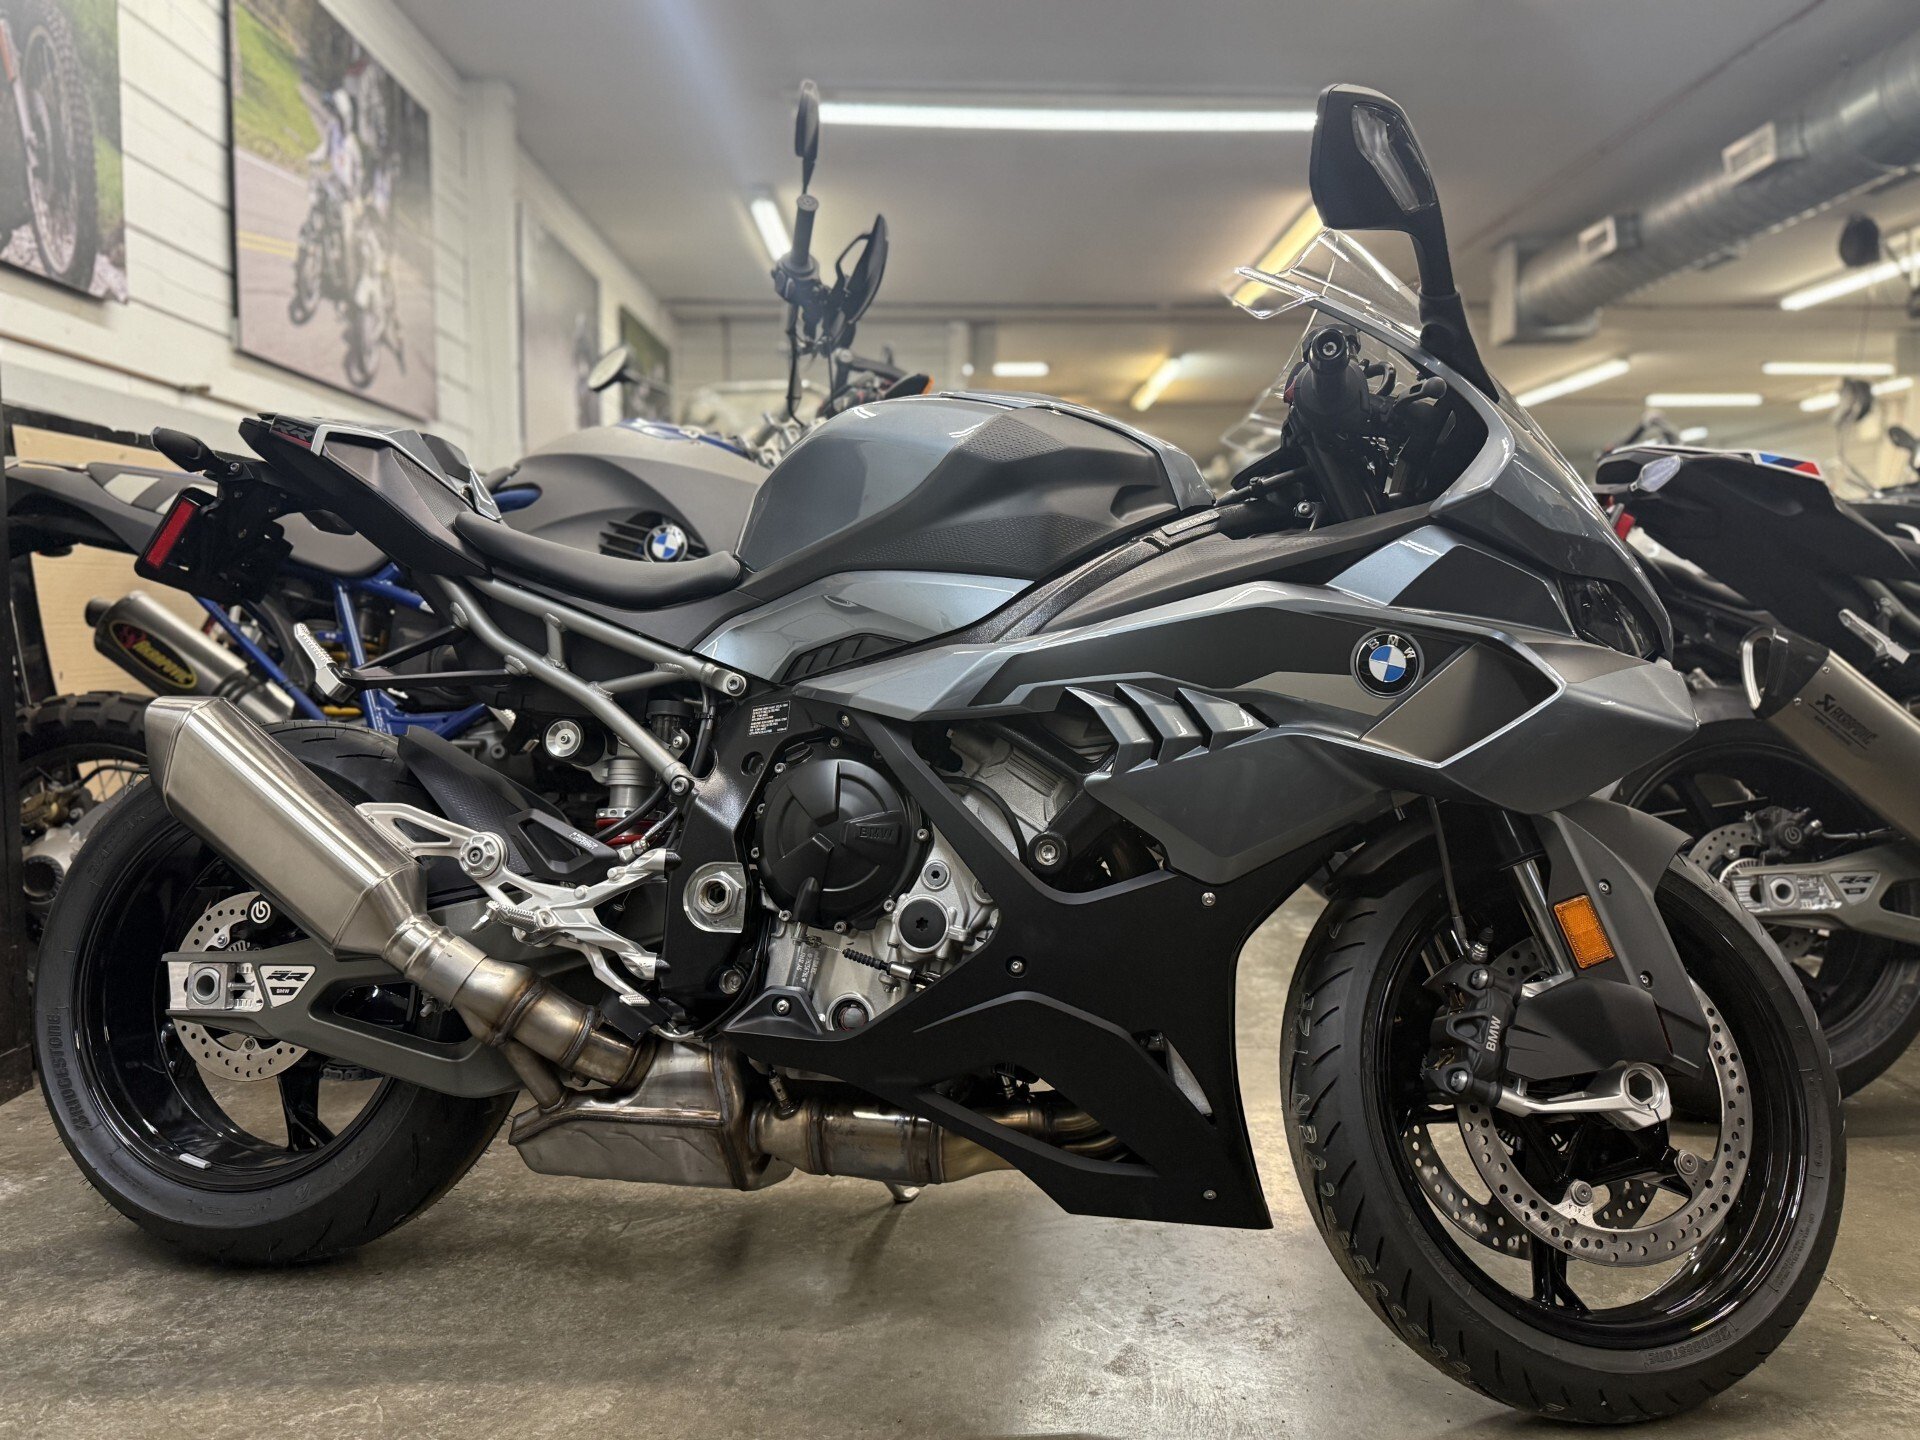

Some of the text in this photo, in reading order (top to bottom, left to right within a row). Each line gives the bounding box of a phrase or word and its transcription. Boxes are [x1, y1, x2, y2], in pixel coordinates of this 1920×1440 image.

[1367, 634, 1417, 659] BMW
[859, 826, 896, 840] BMW
[1485, 1015, 1502, 1052] BMW
